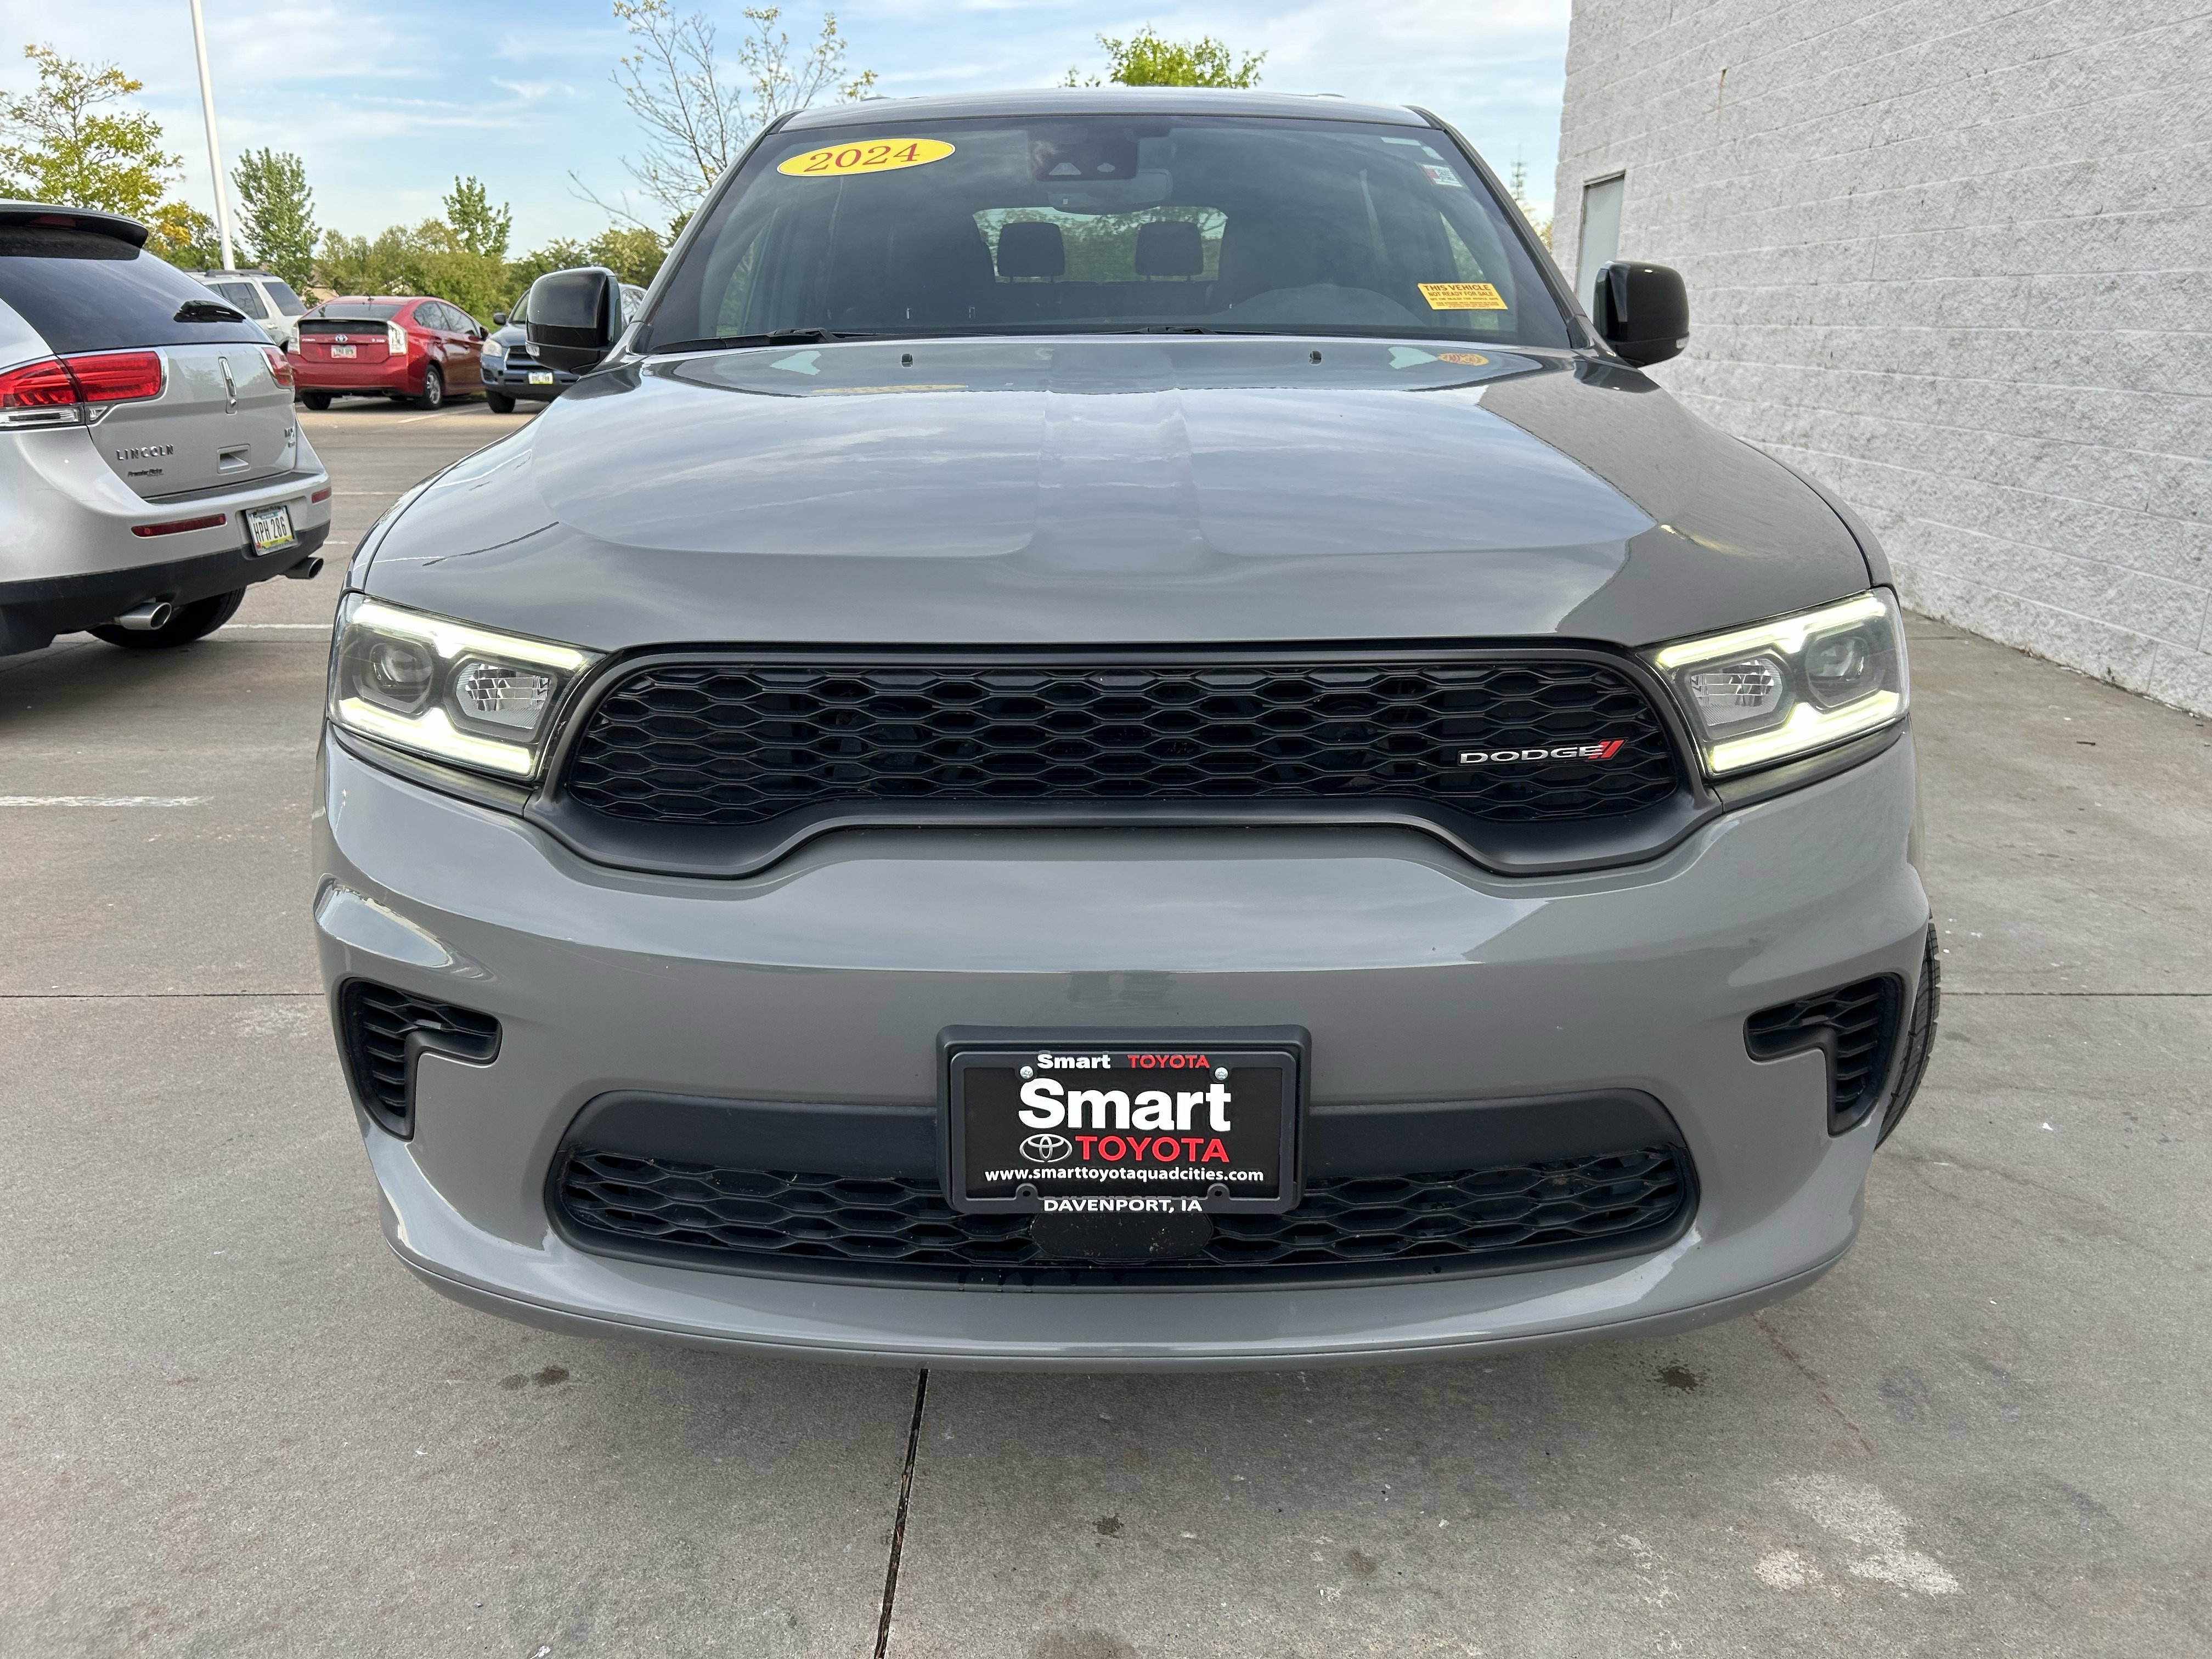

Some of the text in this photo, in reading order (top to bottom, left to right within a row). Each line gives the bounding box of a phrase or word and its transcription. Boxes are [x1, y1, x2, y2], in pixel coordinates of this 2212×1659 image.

[803, 143, 921, 172] 2024
[116, 443, 174, 460] LINCOLN
[253, 516, 287, 543] HPH 286
[1460, 744, 1604, 764] DODGE
[1037, 1053, 1210, 1069] Smart TOYOTA
[1018, 1077, 1232, 1132] Smart
[1075, 1135, 1230, 1163] TOYOTA
[985, 1165, 1263, 1183] www.smarttoyotaquadcities.com
[1043, 1199, 1203, 1214] DAVENPORT, IA
